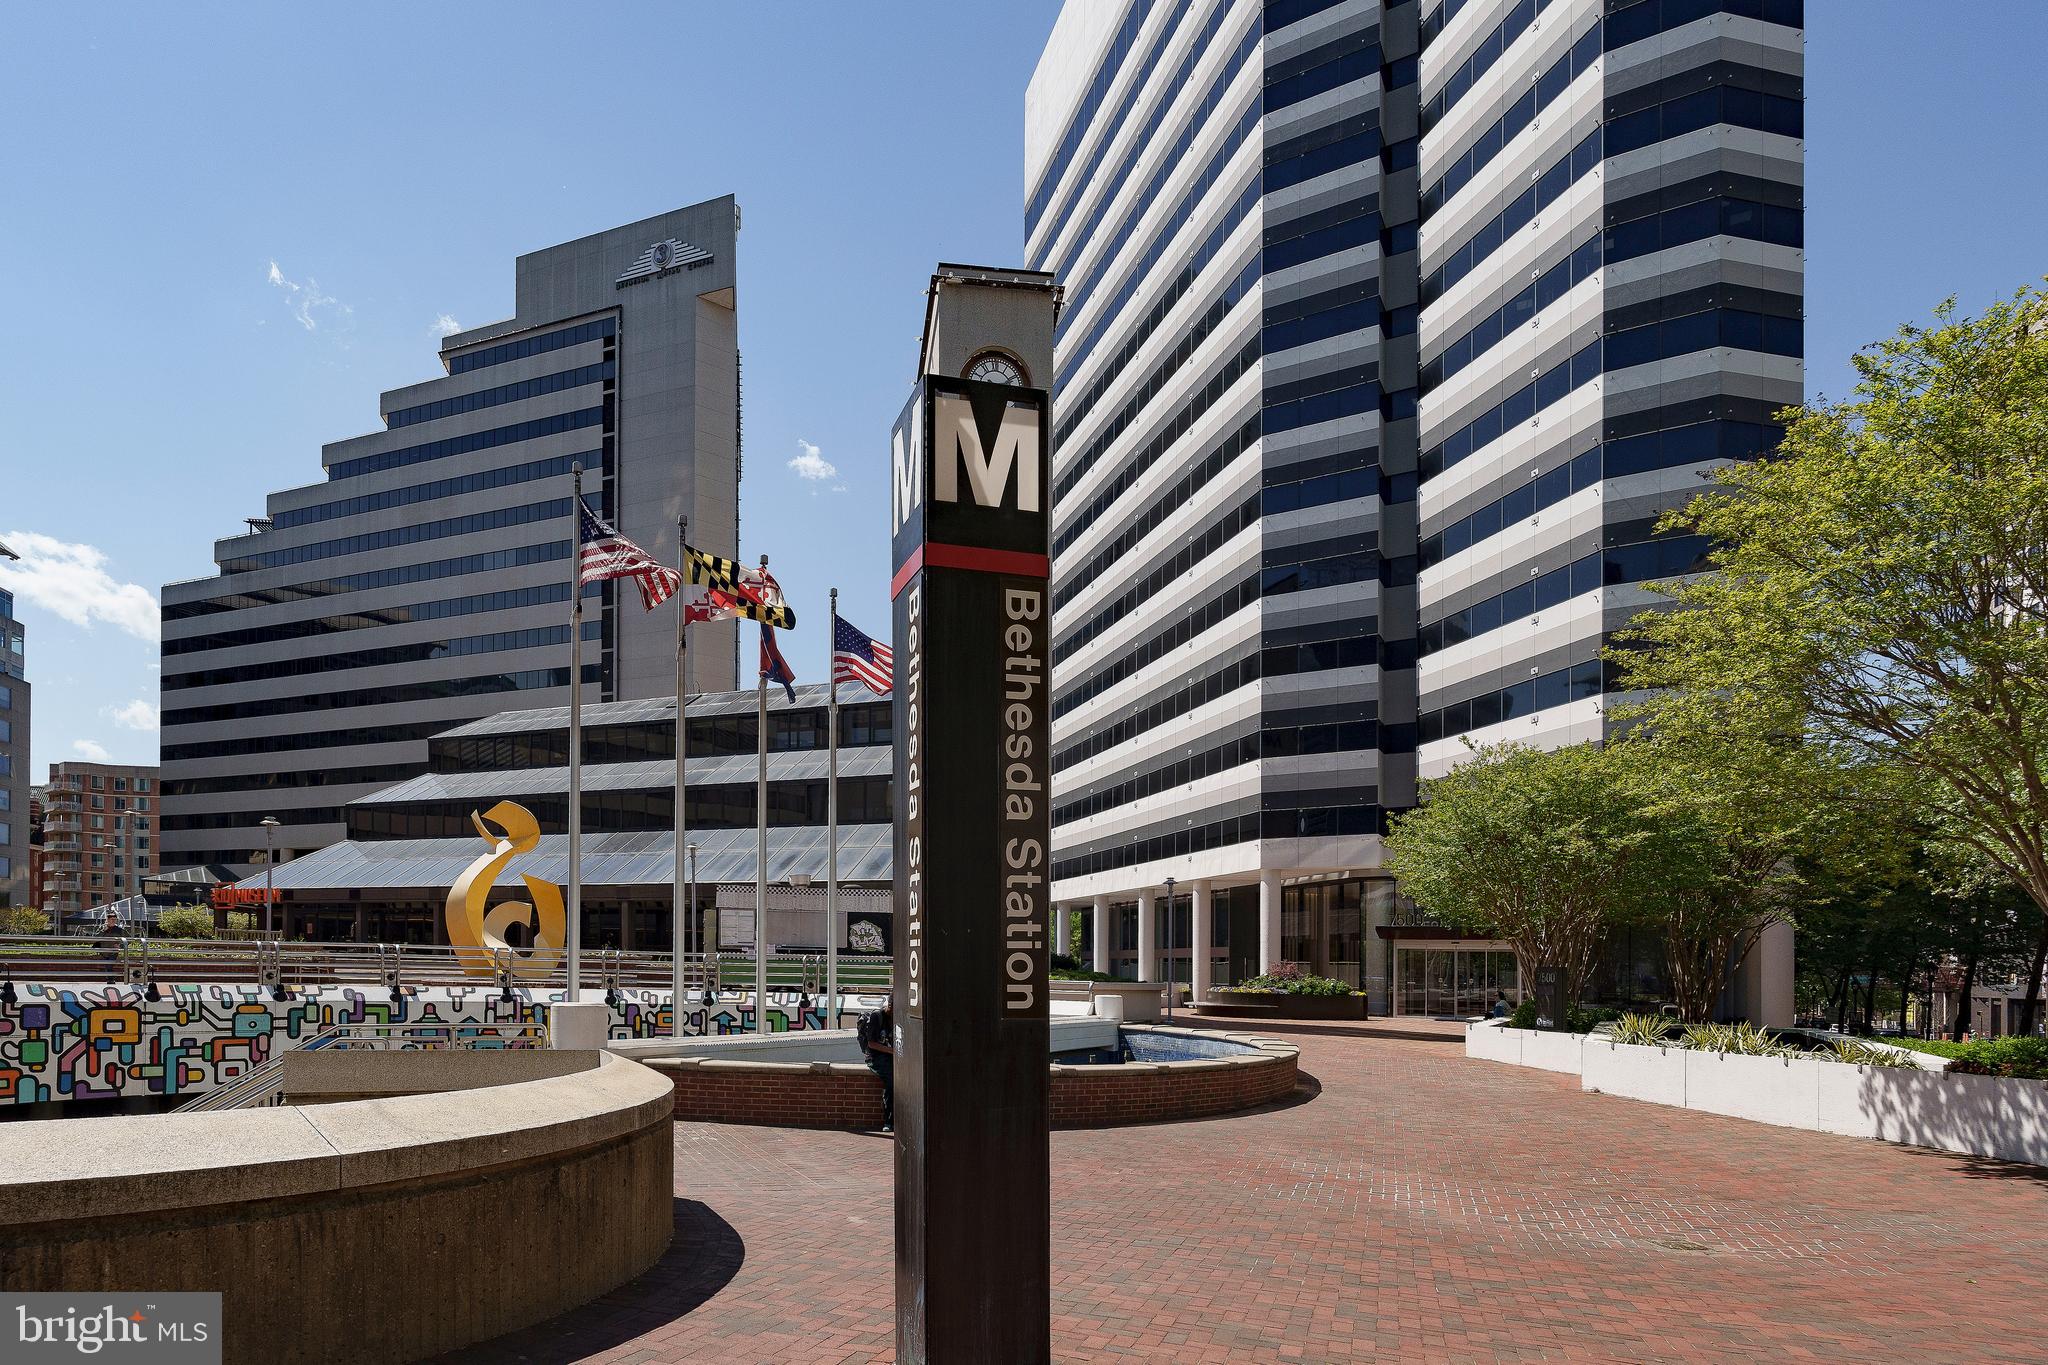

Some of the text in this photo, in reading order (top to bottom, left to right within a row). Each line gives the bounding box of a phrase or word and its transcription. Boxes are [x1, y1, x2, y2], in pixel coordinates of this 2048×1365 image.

[893, 395, 922, 538] M
[935, 388, 1039, 513] M
[908, 585, 921, 1007] Bethesda Station
[1005, 588, 1042, 1010] Bethesda Station
